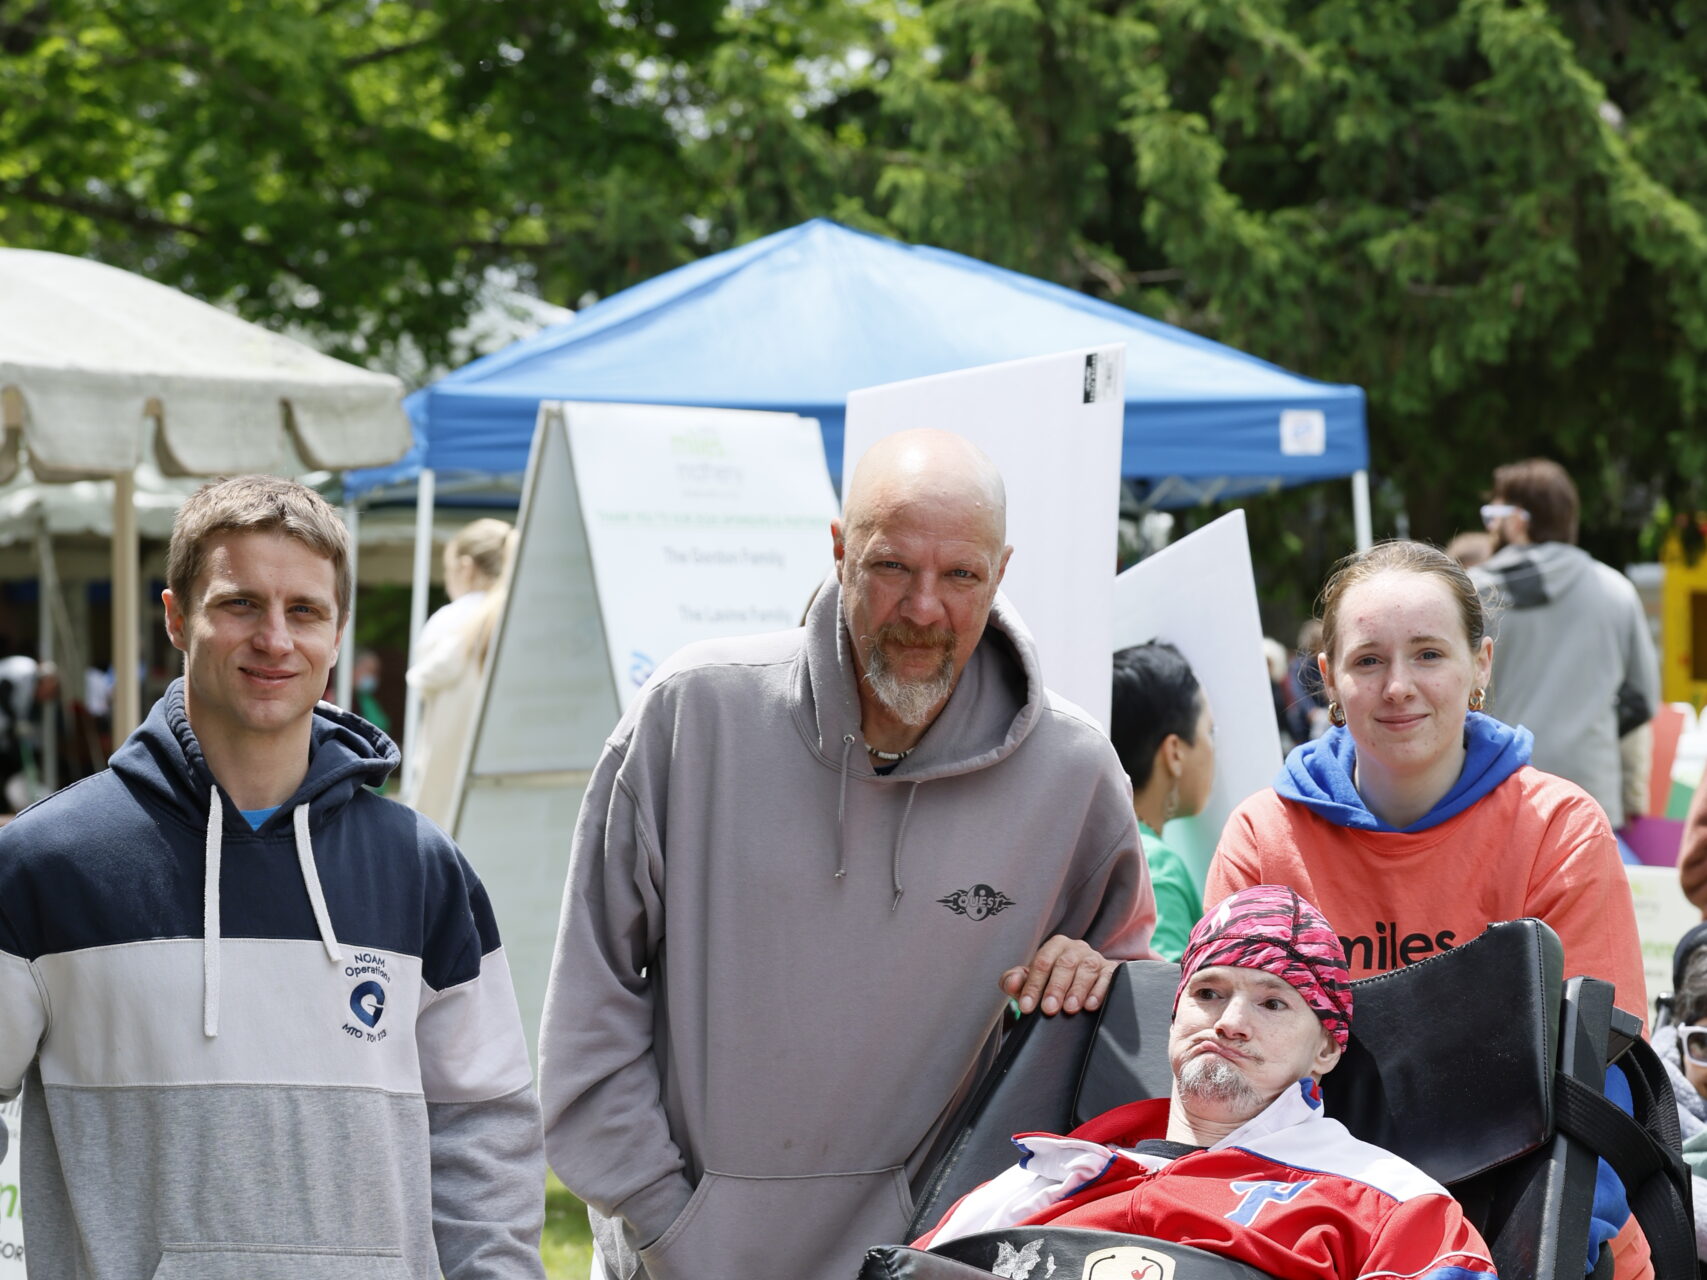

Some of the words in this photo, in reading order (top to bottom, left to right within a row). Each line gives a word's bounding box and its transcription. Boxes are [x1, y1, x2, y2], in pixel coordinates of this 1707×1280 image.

[957, 895, 1001, 908] QUEST
[354, 953, 385, 968] NOAM
[345, 966, 391, 983] Operations
[342, 1022, 363, 1039] MTO
